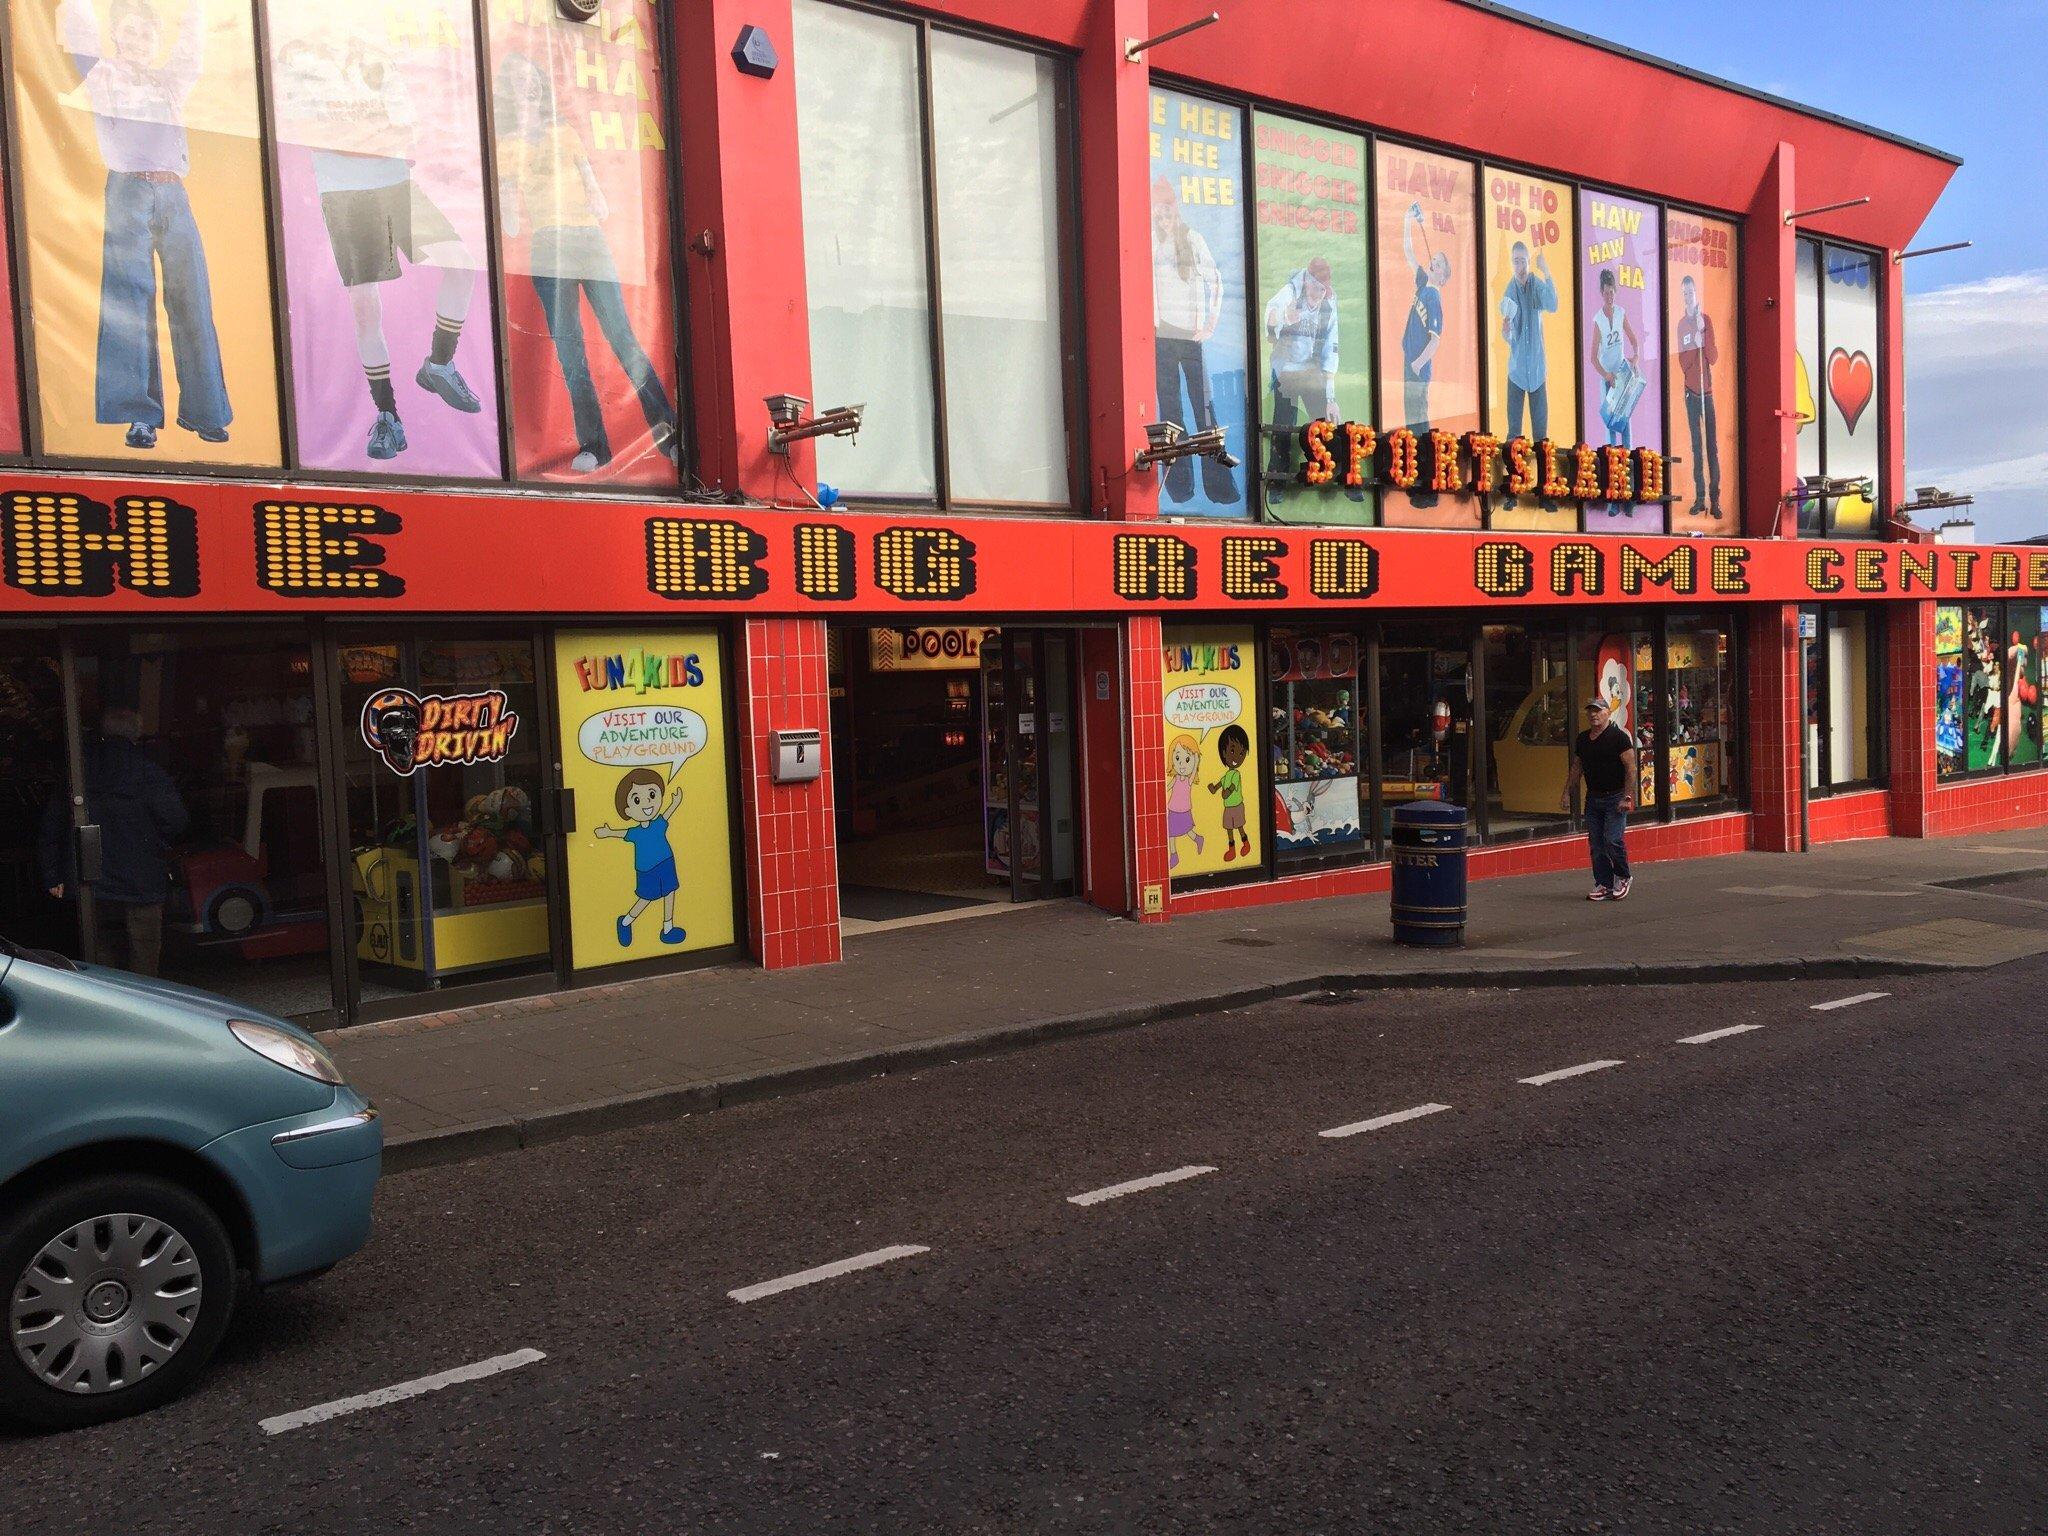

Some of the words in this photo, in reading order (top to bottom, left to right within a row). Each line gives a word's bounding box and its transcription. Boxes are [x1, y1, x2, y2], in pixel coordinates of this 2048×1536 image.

[575, 49, 650, 101] HA
[590, 110, 666, 150] HA
[1180, 101, 1232, 140] HEE
[1173, 137, 1218, 170] HEE
[1256, 124, 1359, 170] SNIGGER
[1180, 175, 1234, 206] HEE
[1257, 163, 1360, 205] SNIGGER
[1387, 156, 1459, 203] HAW
[1491, 178, 1521, 206] OH
[1529, 185, 1558, 214] HO
[1257, 200, 1359, 234] SNIGGER
[1431, 211, 1456, 235] HA
[1496, 205, 1526, 233] HO
[1591, 201, 1642, 235] HAW
[1530, 220, 1560, 247] HO
[1588, 236, 1625, 265] HAW
[1619, 263, 1645, 290] HA
[1602, 331, 1620, 346] 22
[1302, 418, 1664, 501] SPORTSLAND
[645, 517, 977, 601] BIG
[1113, 534, 1379, 600] RED
[1474, 542, 1750, 597] GAME
[1806, 547, 2048, 593] CENTRE
[901, 629, 980, 660] POOL
[1176, 699, 1231, 711] ADVENTURE
[1179, 688, 1205, 700] VISIT
[1209, 687, 1228, 698] OUR
[420, 691, 504, 732] DIRTY
[602, 711, 648, 728] VISIT
[654, 710, 684, 725] OUR
[1172, 710, 1236, 723] PLAYGROUND
[599, 725, 689, 743] ADVENTURE
[592, 740, 697, 760] PLAYGROUND
